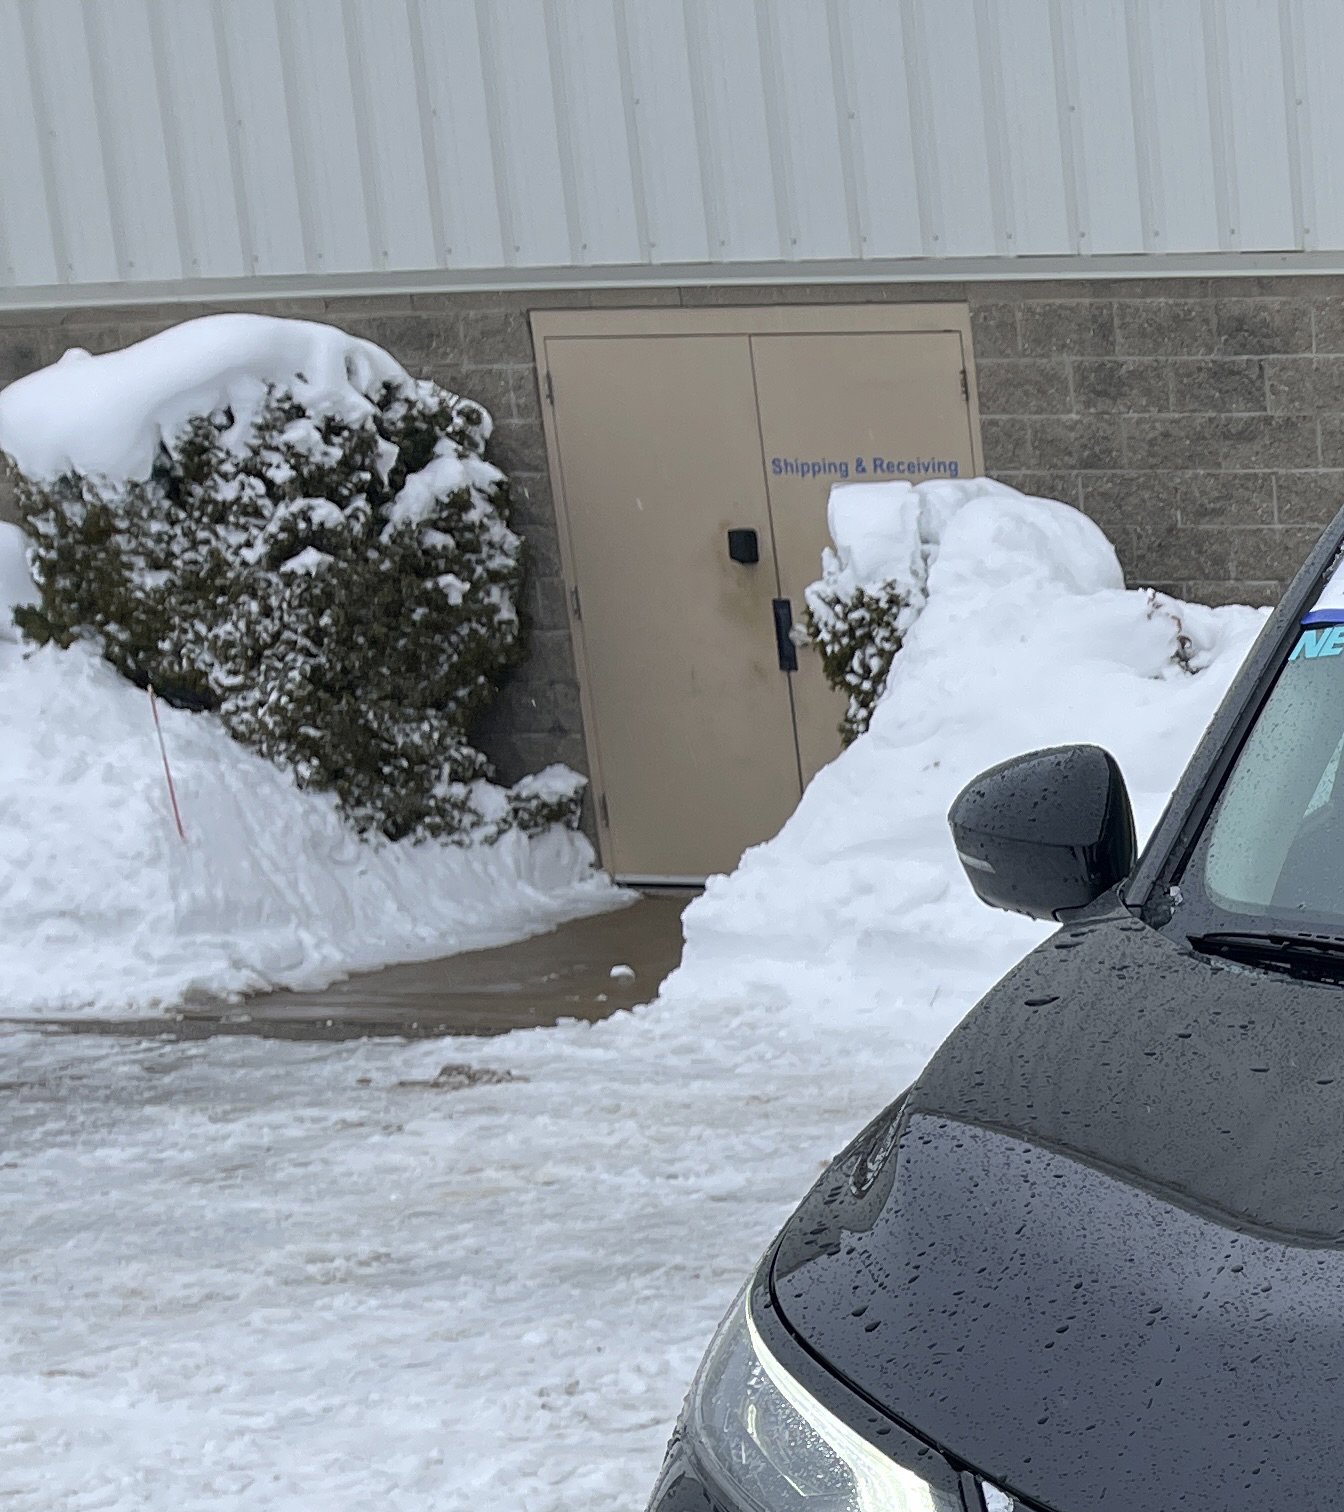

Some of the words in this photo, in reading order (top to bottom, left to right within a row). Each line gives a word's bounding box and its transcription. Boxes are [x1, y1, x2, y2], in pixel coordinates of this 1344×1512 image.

[771, 457, 849, 478] Shipping
[855, 457, 867, 474] &
[873, 457, 959, 477] Receiving
